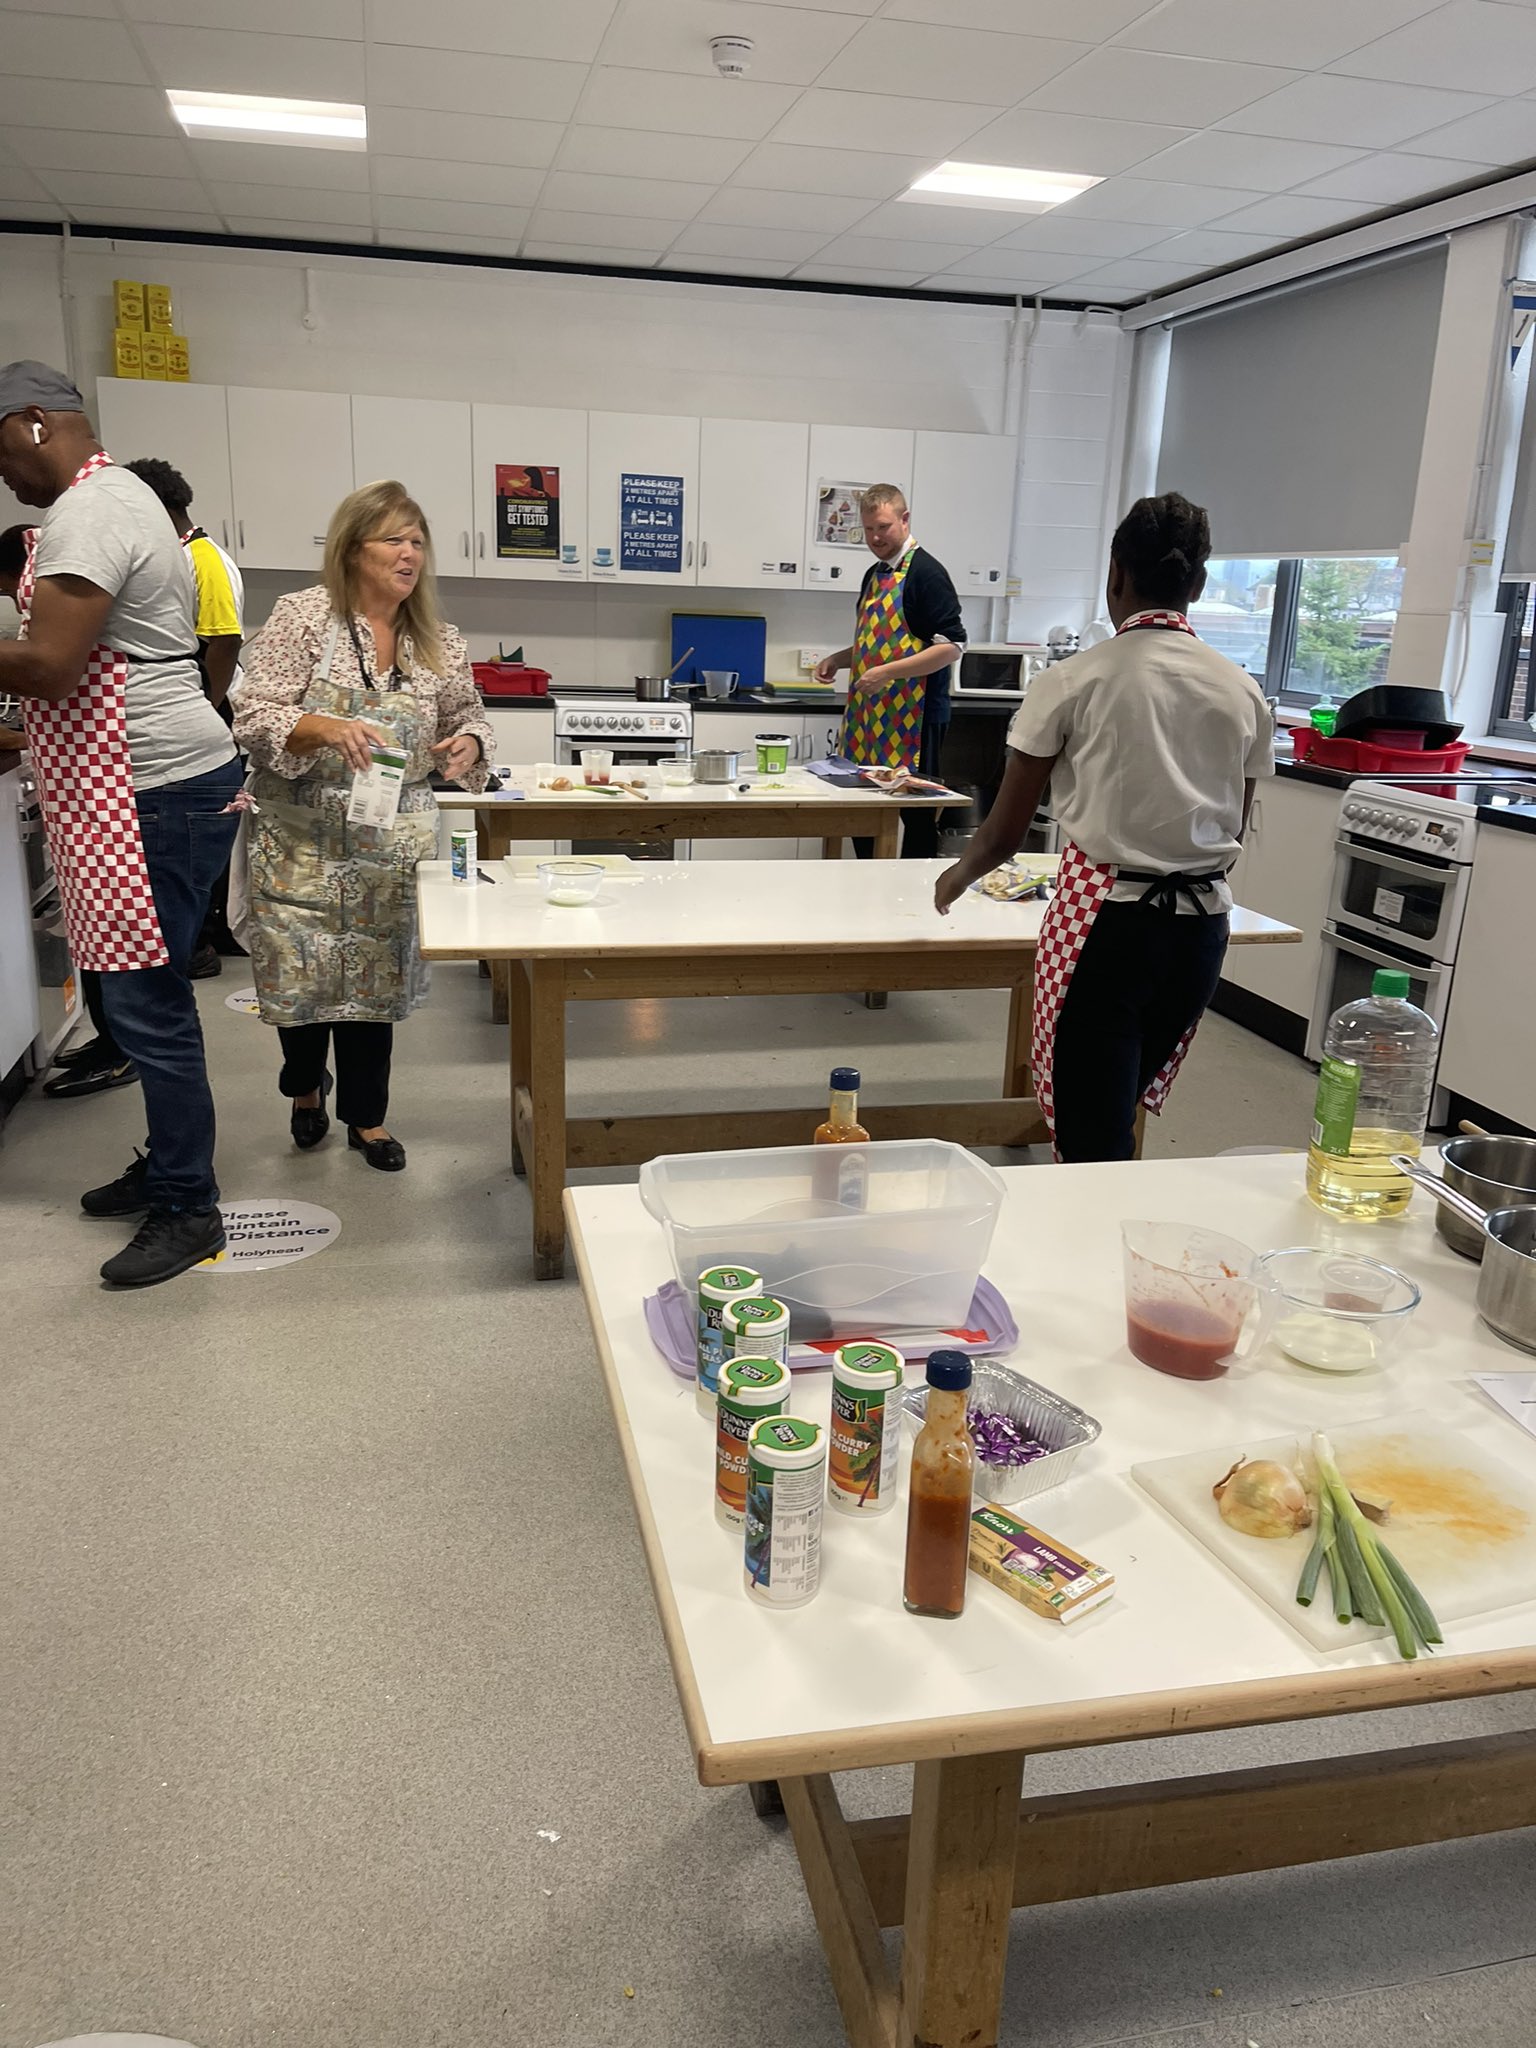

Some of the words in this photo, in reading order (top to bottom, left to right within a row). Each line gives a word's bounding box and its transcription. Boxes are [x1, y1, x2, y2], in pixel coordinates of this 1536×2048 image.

[623, 478, 657, 487] PLEASE
[657, 480, 680, 489] KEEP
[657, 489, 679, 497] APART
[625, 495, 636, 503] AT
[637, 496, 653, 504] ALL
[654, 497, 680, 506] TIMES
[637, 508, 648, 516] 2m
[507, 512, 521, 525] GET
[522, 513, 549, 526] TESTED
[623, 531, 656, 541] PLEASE
[656, 533, 680, 542] KEEP
[656, 542, 678, 550] APART
[624, 548, 636, 556] AT
[636, 549, 652, 558] ALL
[653, 550, 678, 559] TIMES
[223, 1219, 301, 1231] aintain
[228, 1227, 331, 1241] Distance
[232, 1246, 305, 1258] Holyhead
[838, 1433, 871, 1451] CURRY
[719, 1457, 747, 1474] POWD
[1033, 1545, 1058, 1562] LAMB
